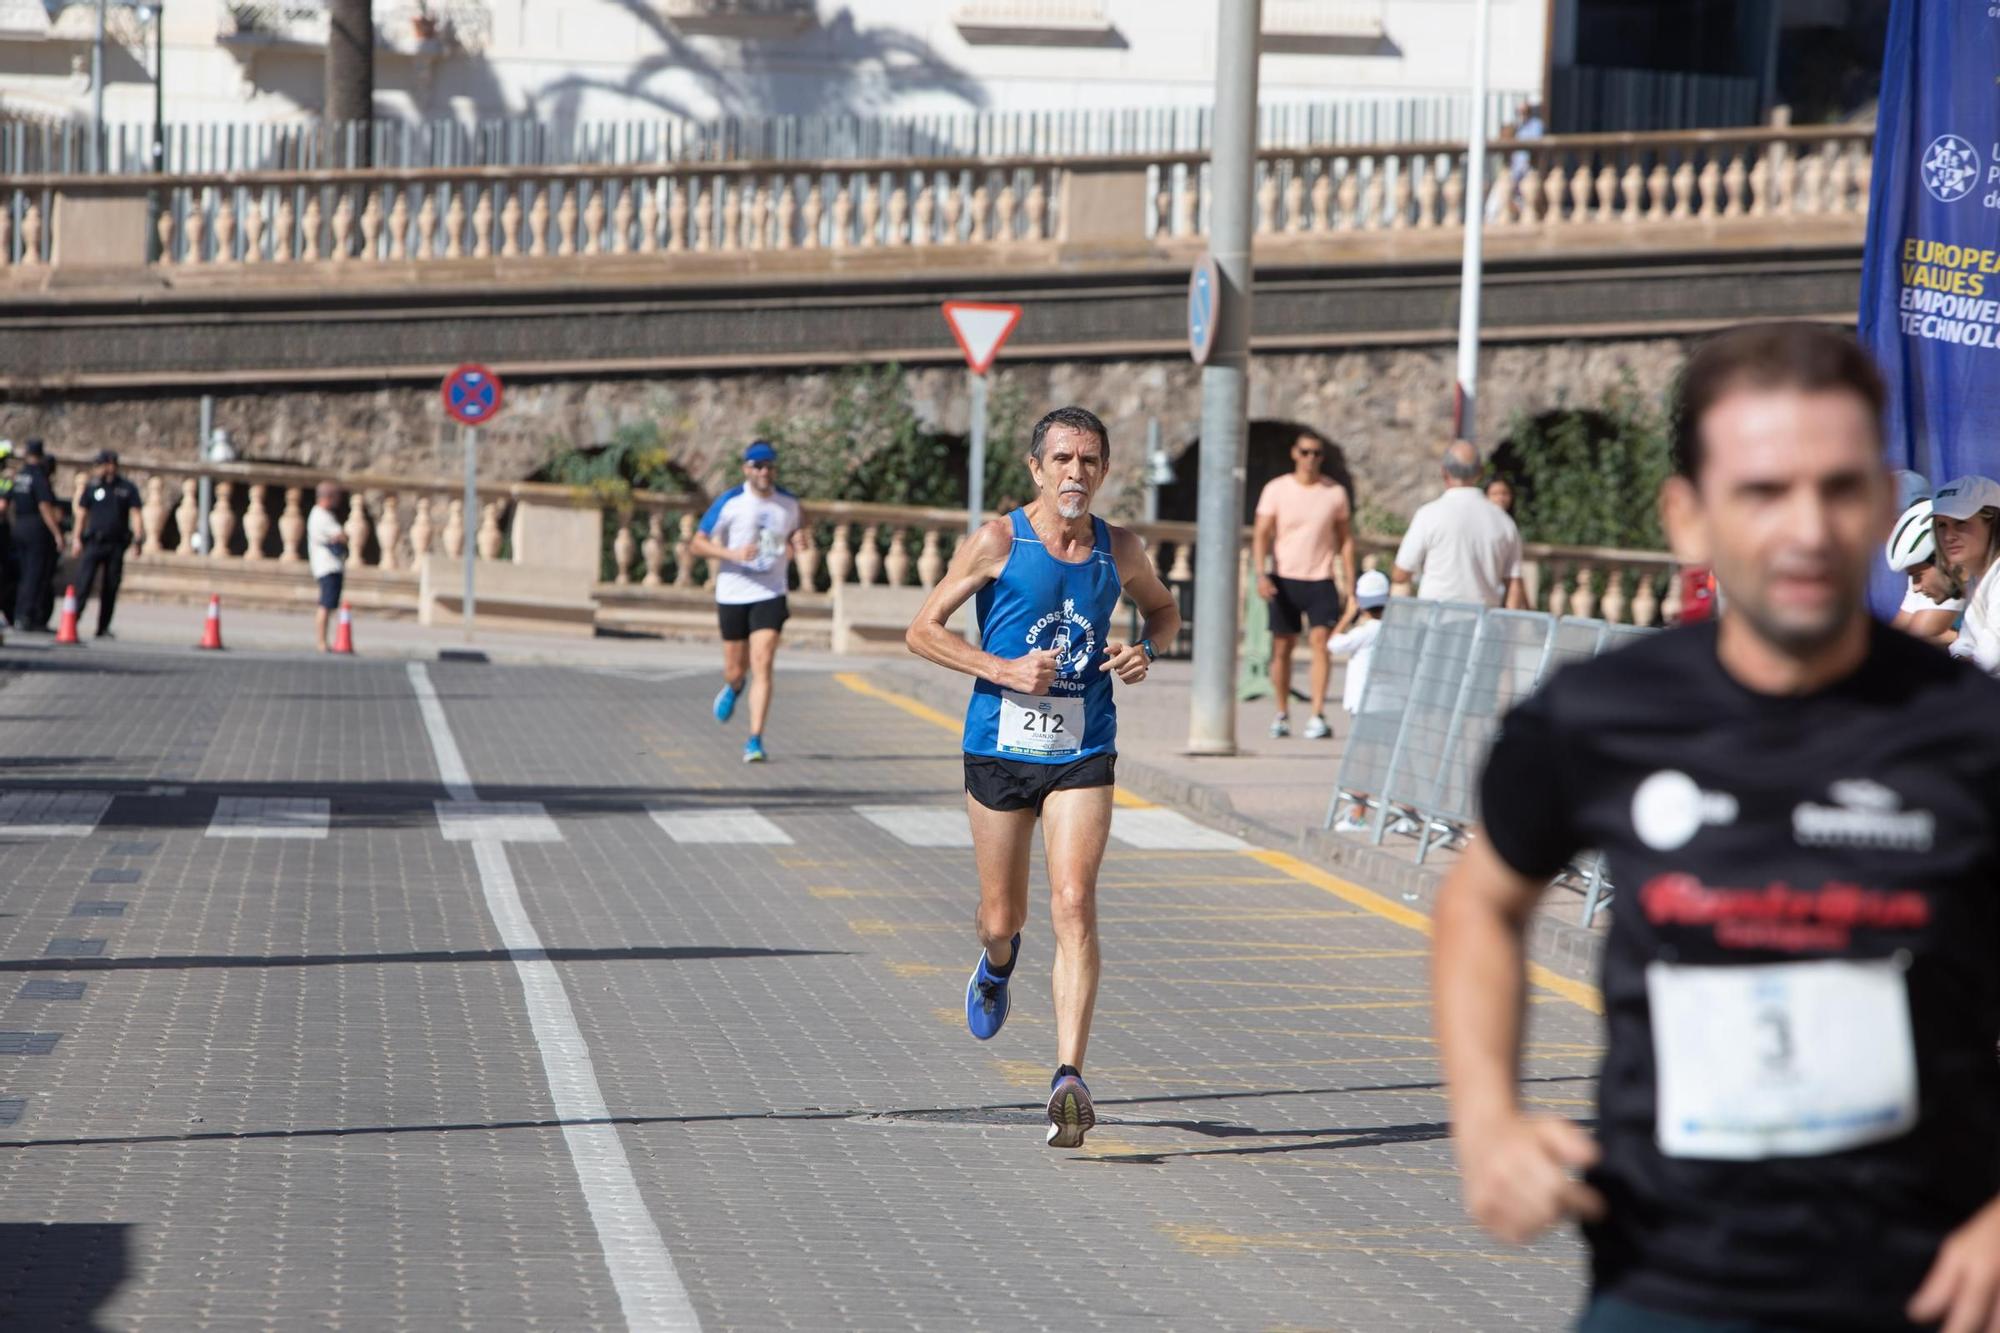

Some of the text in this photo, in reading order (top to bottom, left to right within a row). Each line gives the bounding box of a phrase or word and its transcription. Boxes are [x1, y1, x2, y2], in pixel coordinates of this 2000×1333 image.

[1987, 166, 2000, 184] P
[1902, 263, 1985, 297] VALUES
[1900, 311, 2000, 349] TECHNOL
[1025, 610, 1061, 645] CROSS
[1050, 679, 1086, 692] ENOR
[1023, 711, 1065, 734] 212
